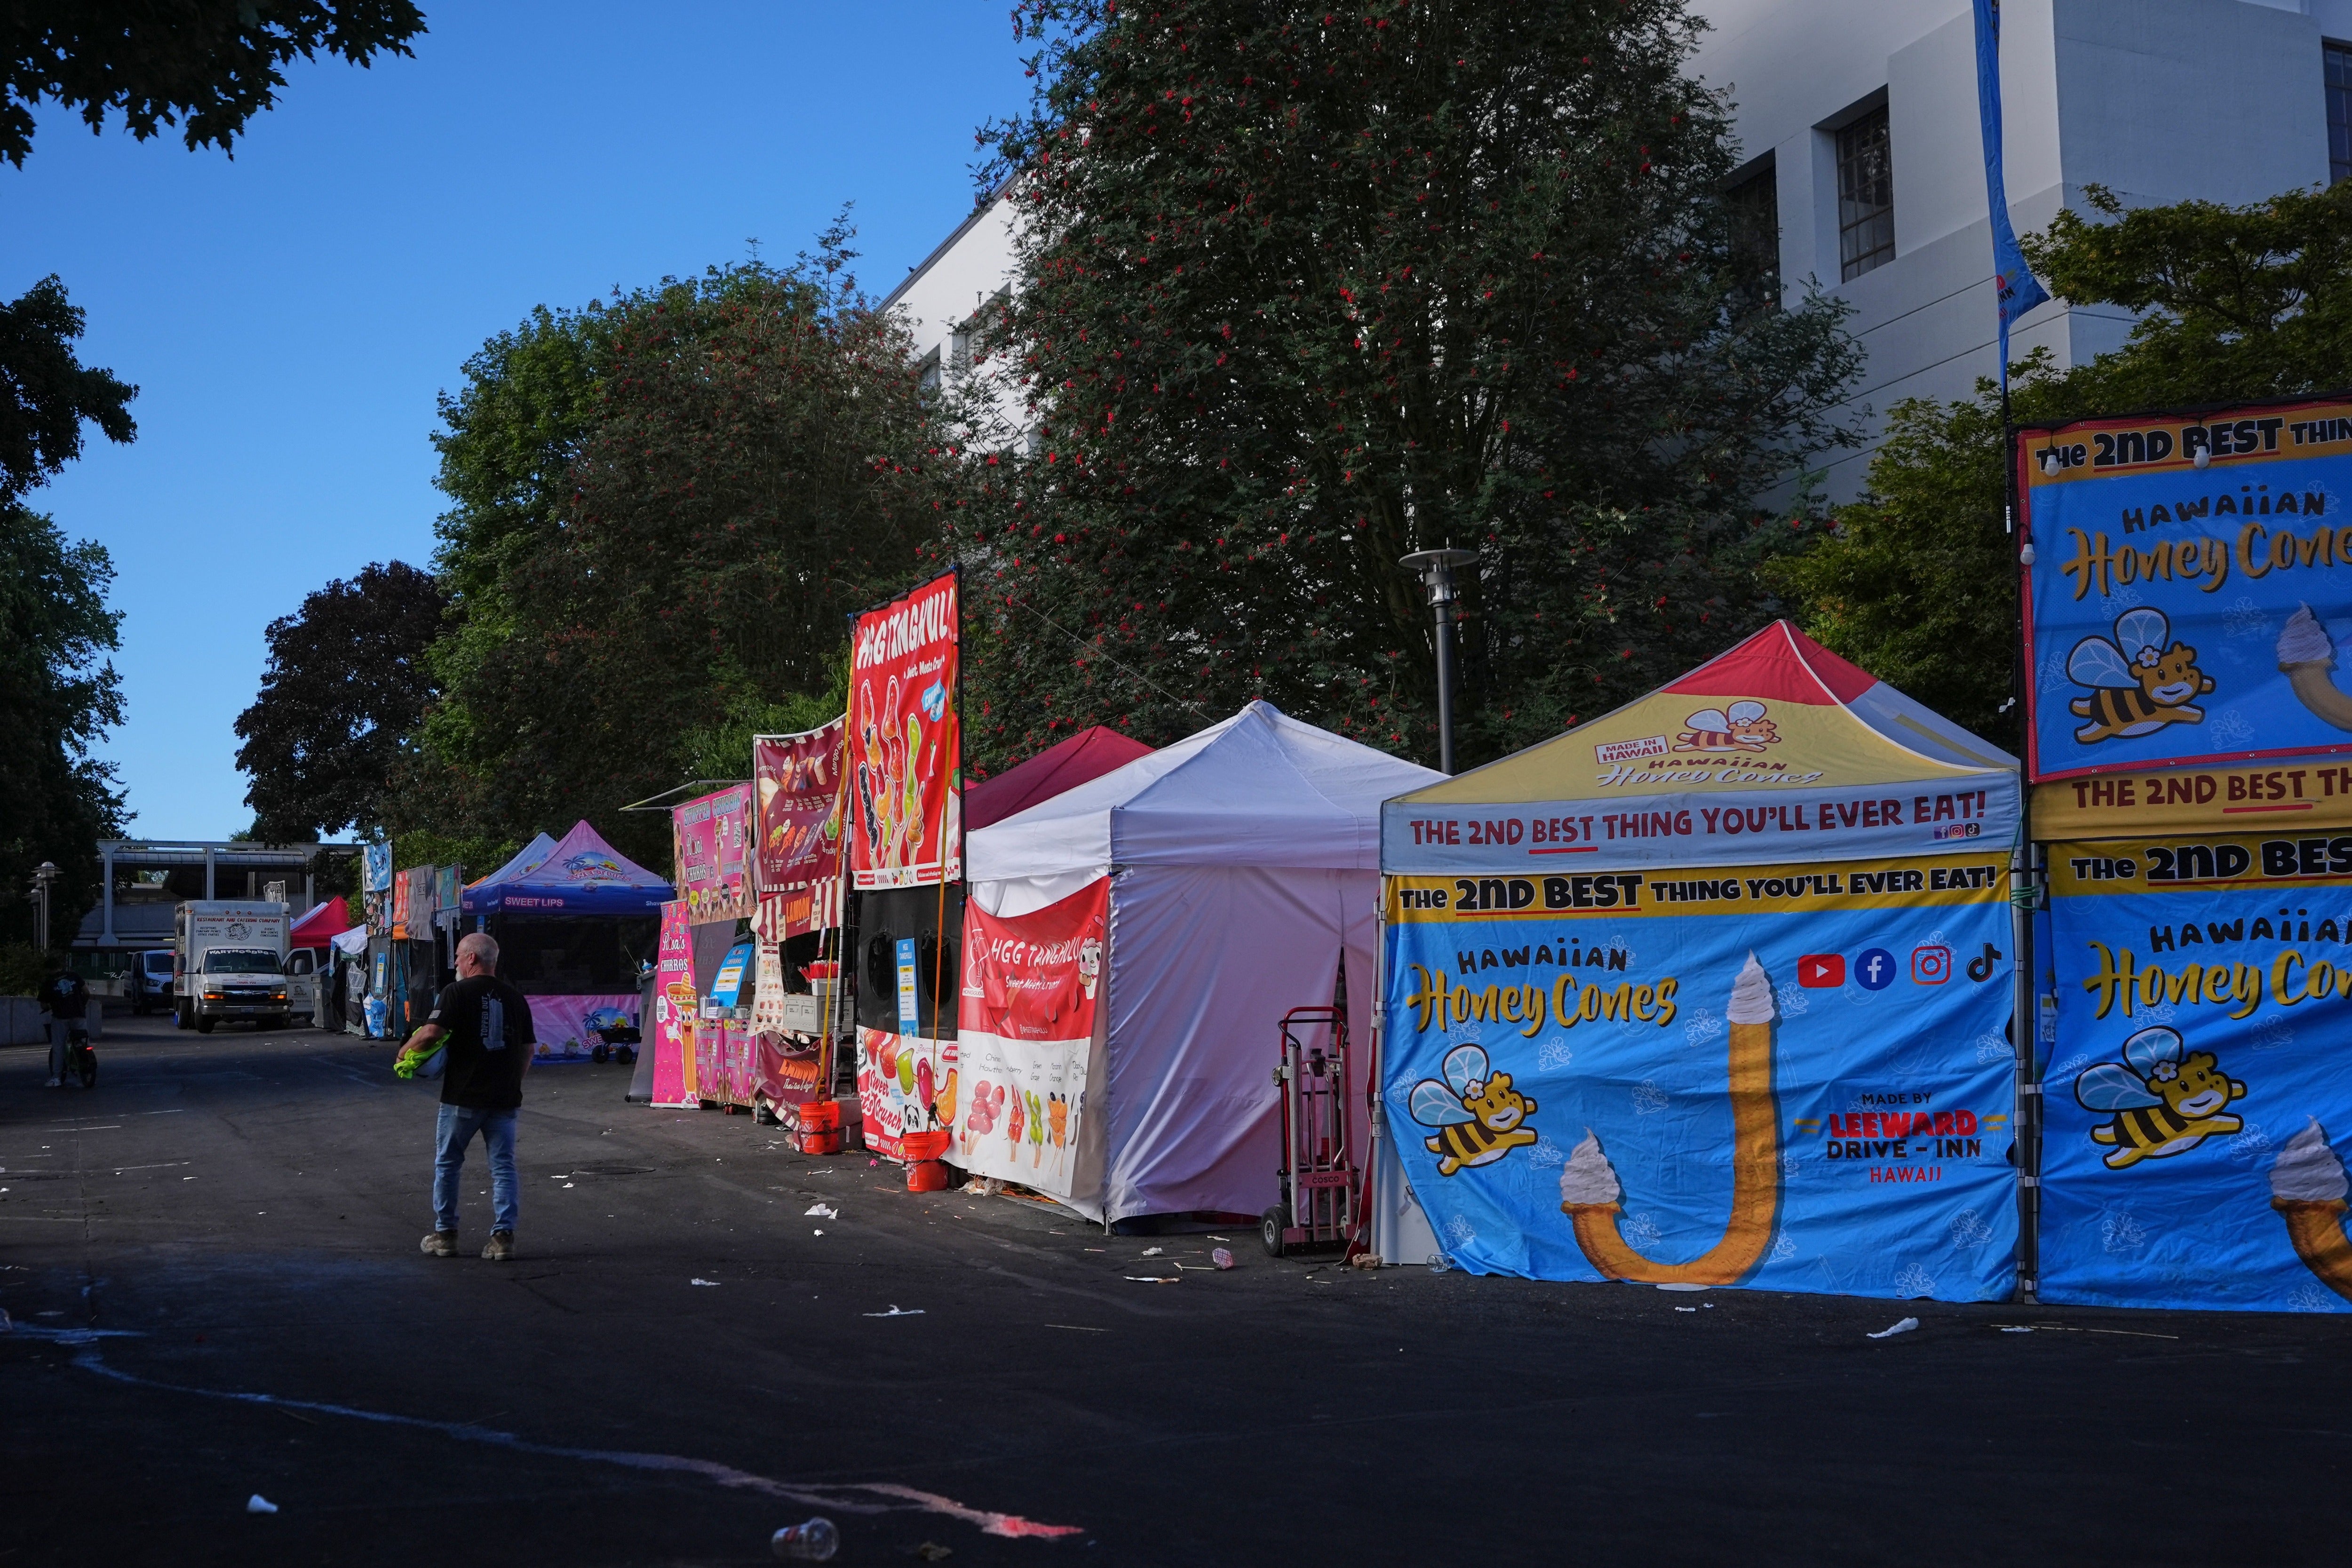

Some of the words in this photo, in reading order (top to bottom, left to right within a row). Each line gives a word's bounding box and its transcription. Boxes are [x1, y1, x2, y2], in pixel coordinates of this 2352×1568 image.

[2183, 417, 2284, 460] BEST
[2061, 526, 2229, 601] Honey
[1602, 744, 1664, 762] HAWAII
[1605, 741, 1639, 752] MADE
[1644, 739, 1656, 747] IN
[1595, 764, 1711, 787] Honey
[1714, 768, 1824, 784] Cones
[2072, 779, 2136, 808] THE
[2145, 775, 2217, 804] 2ND
[2227, 771, 2306, 800] BEST
[1410, 820, 1460, 845] THE
[1468, 818, 1524, 845] 2ND
[1532, 815, 1594, 843] BEST
[1602, 809, 1692, 839] THING
[1700, 804, 1810, 835] YOU'LL
[1819, 798, 1904, 831] EVER
[1913, 790, 1986, 824] EAT!
[566, 869, 605, 881] SWEET
[1542, 874, 1643, 909] BEST
[1650, 878, 1741, 902] THING
[1745, 874, 1844, 899] YOU'LL
[1849, 870, 1924, 895] EVER
[1929, 865, 1997, 890] EAT!
[505, 897, 540, 907] SWEET
[541, 898, 564, 907] LIPS
[786, 896, 810, 923] LAMOON
[991, 938, 1026, 965] HGG
[1027, 935, 1081, 967] TANGHULU
[660, 958, 688, 972] CHURROS
[1005, 975, 1023, 988] Sweet
[1022, 978, 1042, 989] Meets
[2082, 941, 2262, 1020] Honey
[1406, 963, 1546, 1038] Honey
[1553, 973, 1679, 1028] Cones
[480, 1011, 489, 1038] TOPPED
[582, 1034, 604, 1049] SWE
[869, 1069, 890, 1098] Sweet
[1861, 1093, 1906, 1106] MADE
[1913, 1092, 1932, 1104] BY
[875, 1098, 902, 1130] Crunch
[1829, 1109, 1979, 1138] LEEWARD
[1827, 1139, 1907, 1159] DRIVE
[1936, 1138, 1982, 1158] INN
[1312, 1176, 1339, 1184] COSCO
[1870, 1167, 1942, 1183] HAWAII
